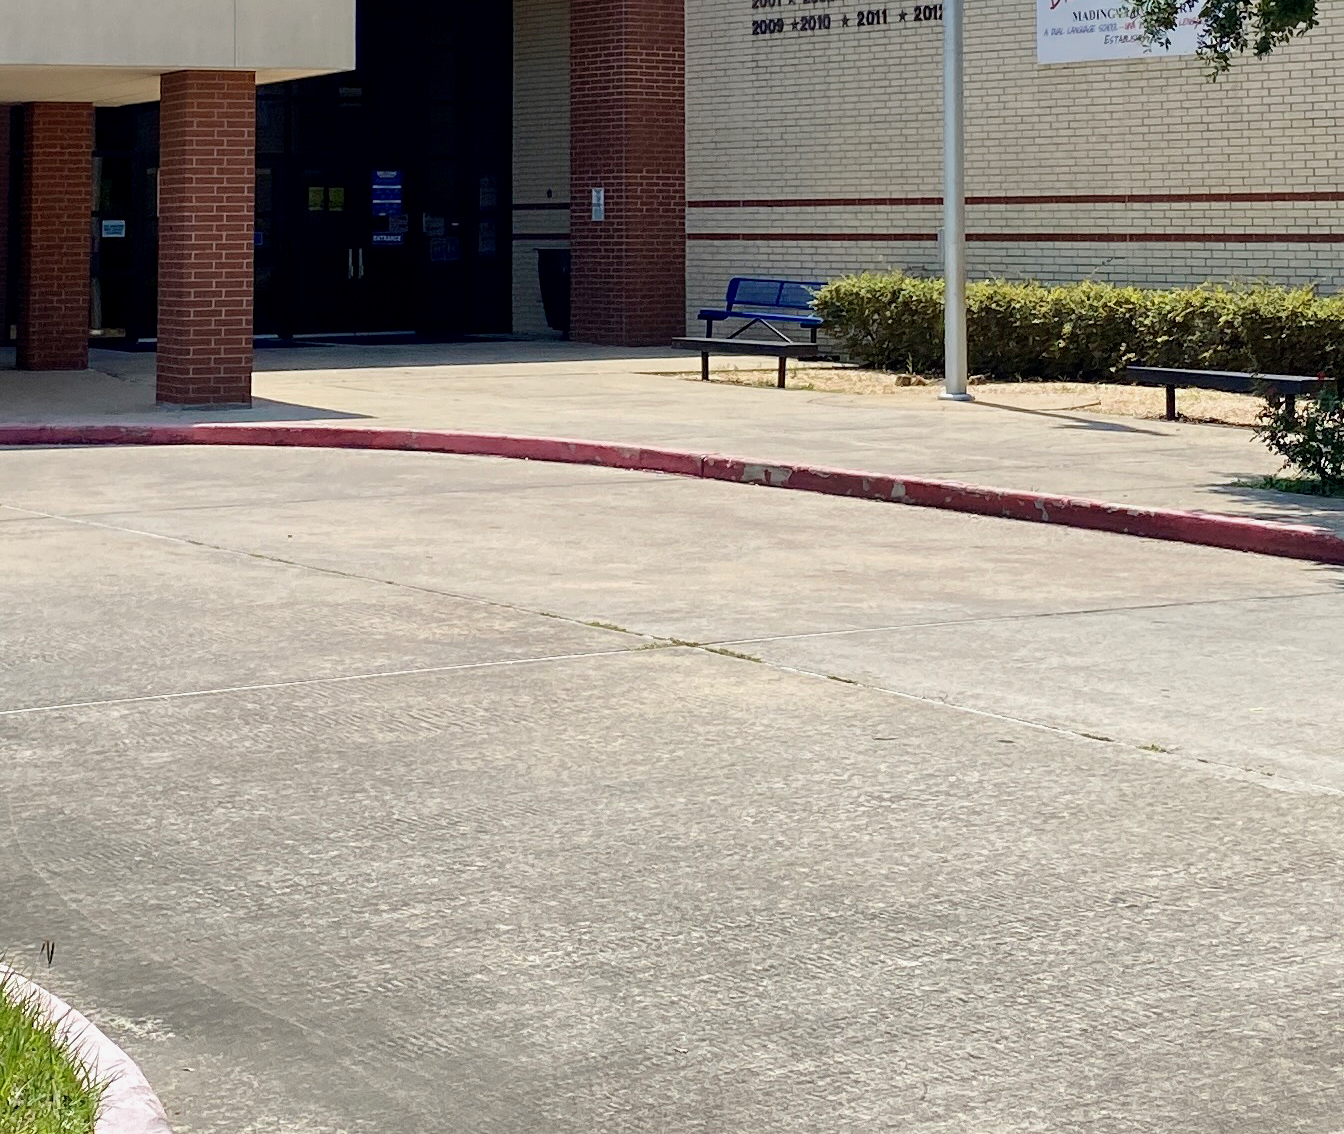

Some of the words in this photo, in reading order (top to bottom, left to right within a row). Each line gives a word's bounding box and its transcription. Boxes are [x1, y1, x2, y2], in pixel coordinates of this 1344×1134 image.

[752, 18, 784, 35] 2009
[800, 14, 831, 31] 2010
[857, 9, 888, 26] 2011
[1073, 8, 1117, 22] MADING
